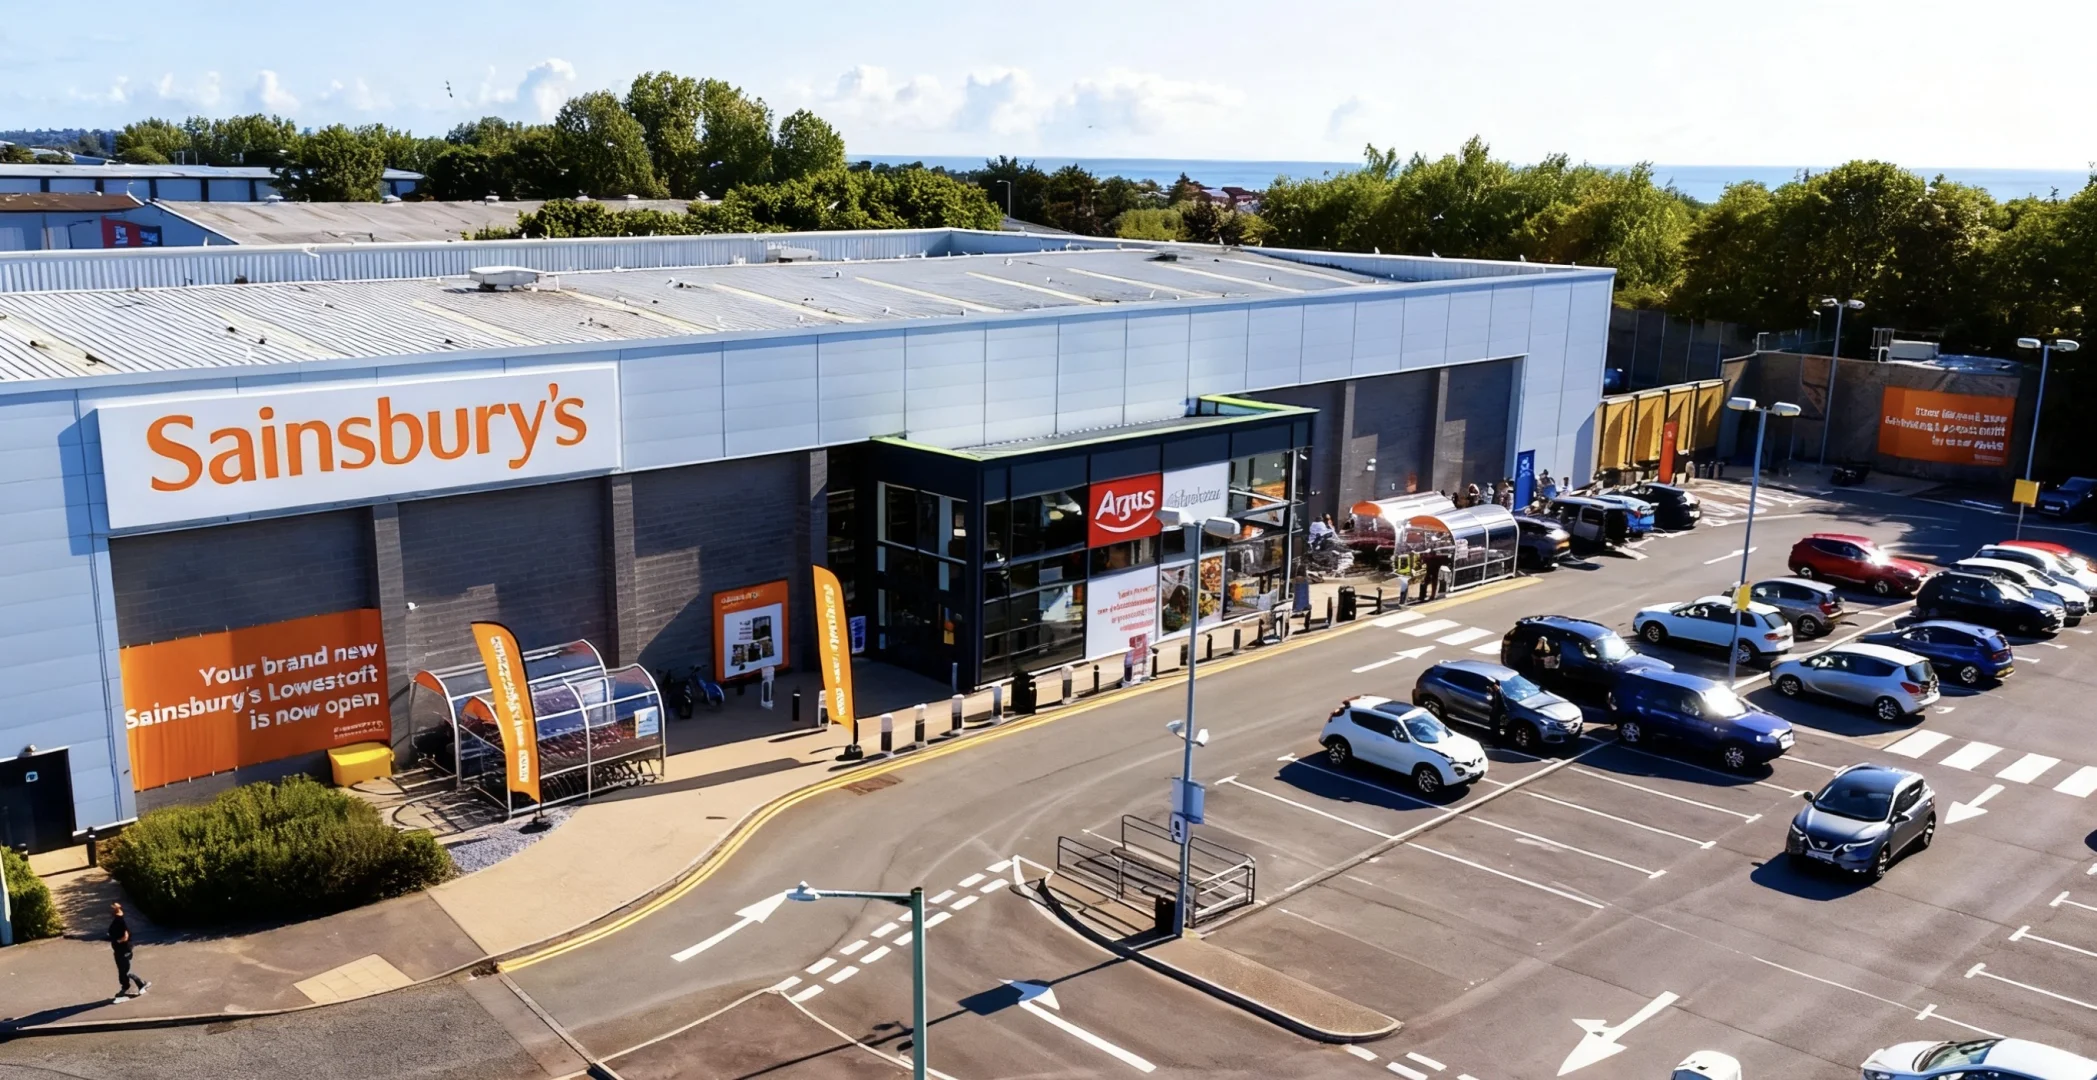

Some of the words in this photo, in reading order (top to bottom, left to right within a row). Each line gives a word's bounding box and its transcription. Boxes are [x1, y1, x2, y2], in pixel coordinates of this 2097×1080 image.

[146, 383, 588, 492] Sainsbury's
[199, 664, 257, 687] Your
[261, 645, 329, 677] brand
[333, 643, 378, 664] new
[124, 686, 261, 730] Sainsbury's
[268, 664, 378, 702] Lowestoft
[250, 709, 271, 731] is
[275, 702, 320, 726] now
[325, 691, 380, 719] open
